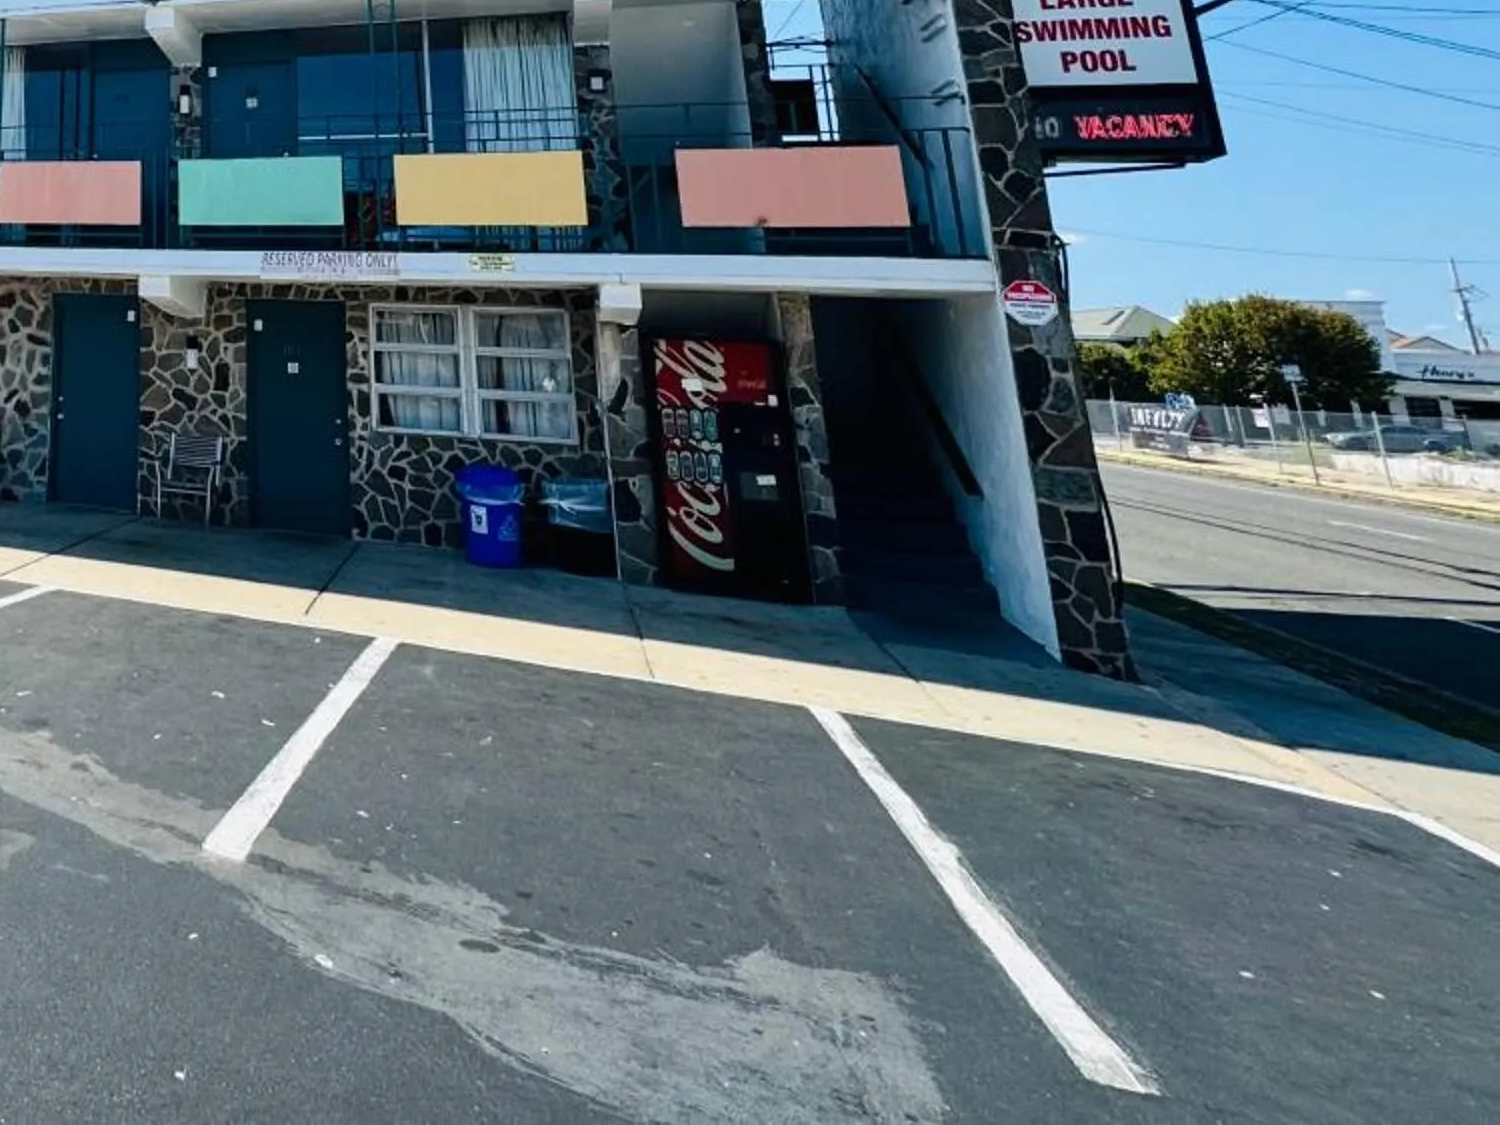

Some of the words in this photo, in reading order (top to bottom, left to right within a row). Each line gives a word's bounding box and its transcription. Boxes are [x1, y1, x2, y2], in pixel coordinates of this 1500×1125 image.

[1015, 15, 1172, 43] SWIMMING
[1060, 50, 1137, 73] POOL
[1072, 112, 1194, 140] VACANCY
